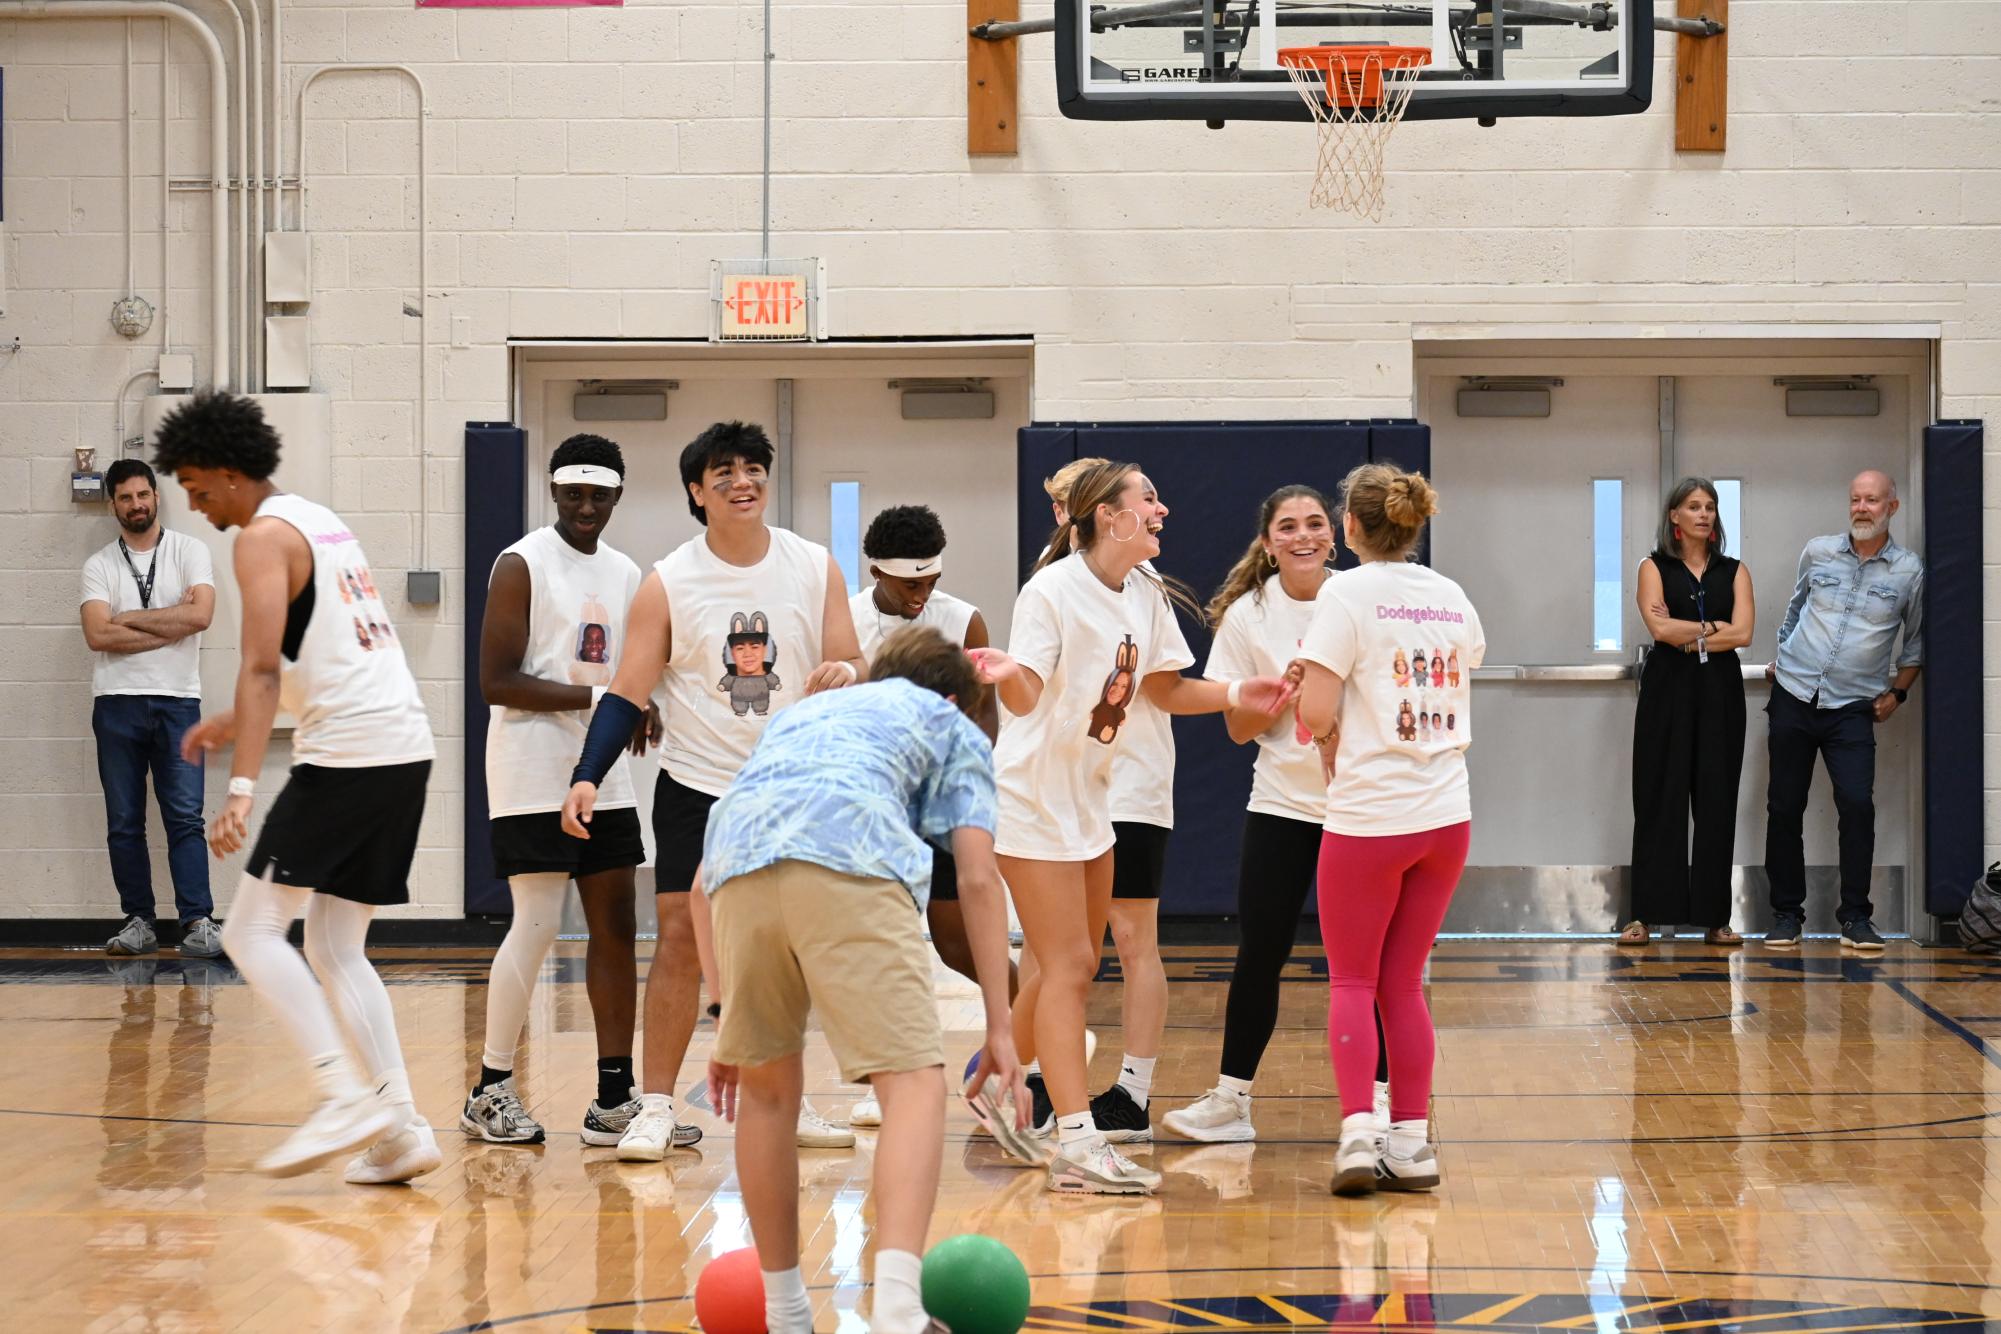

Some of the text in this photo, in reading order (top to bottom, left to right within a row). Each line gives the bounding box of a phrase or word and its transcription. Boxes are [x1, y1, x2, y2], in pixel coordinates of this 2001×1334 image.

[1144, 68, 1212, 79] GARED
[736, 281, 795, 324] EXIT
[1376, 605, 1464, 625] Dodegebubus
